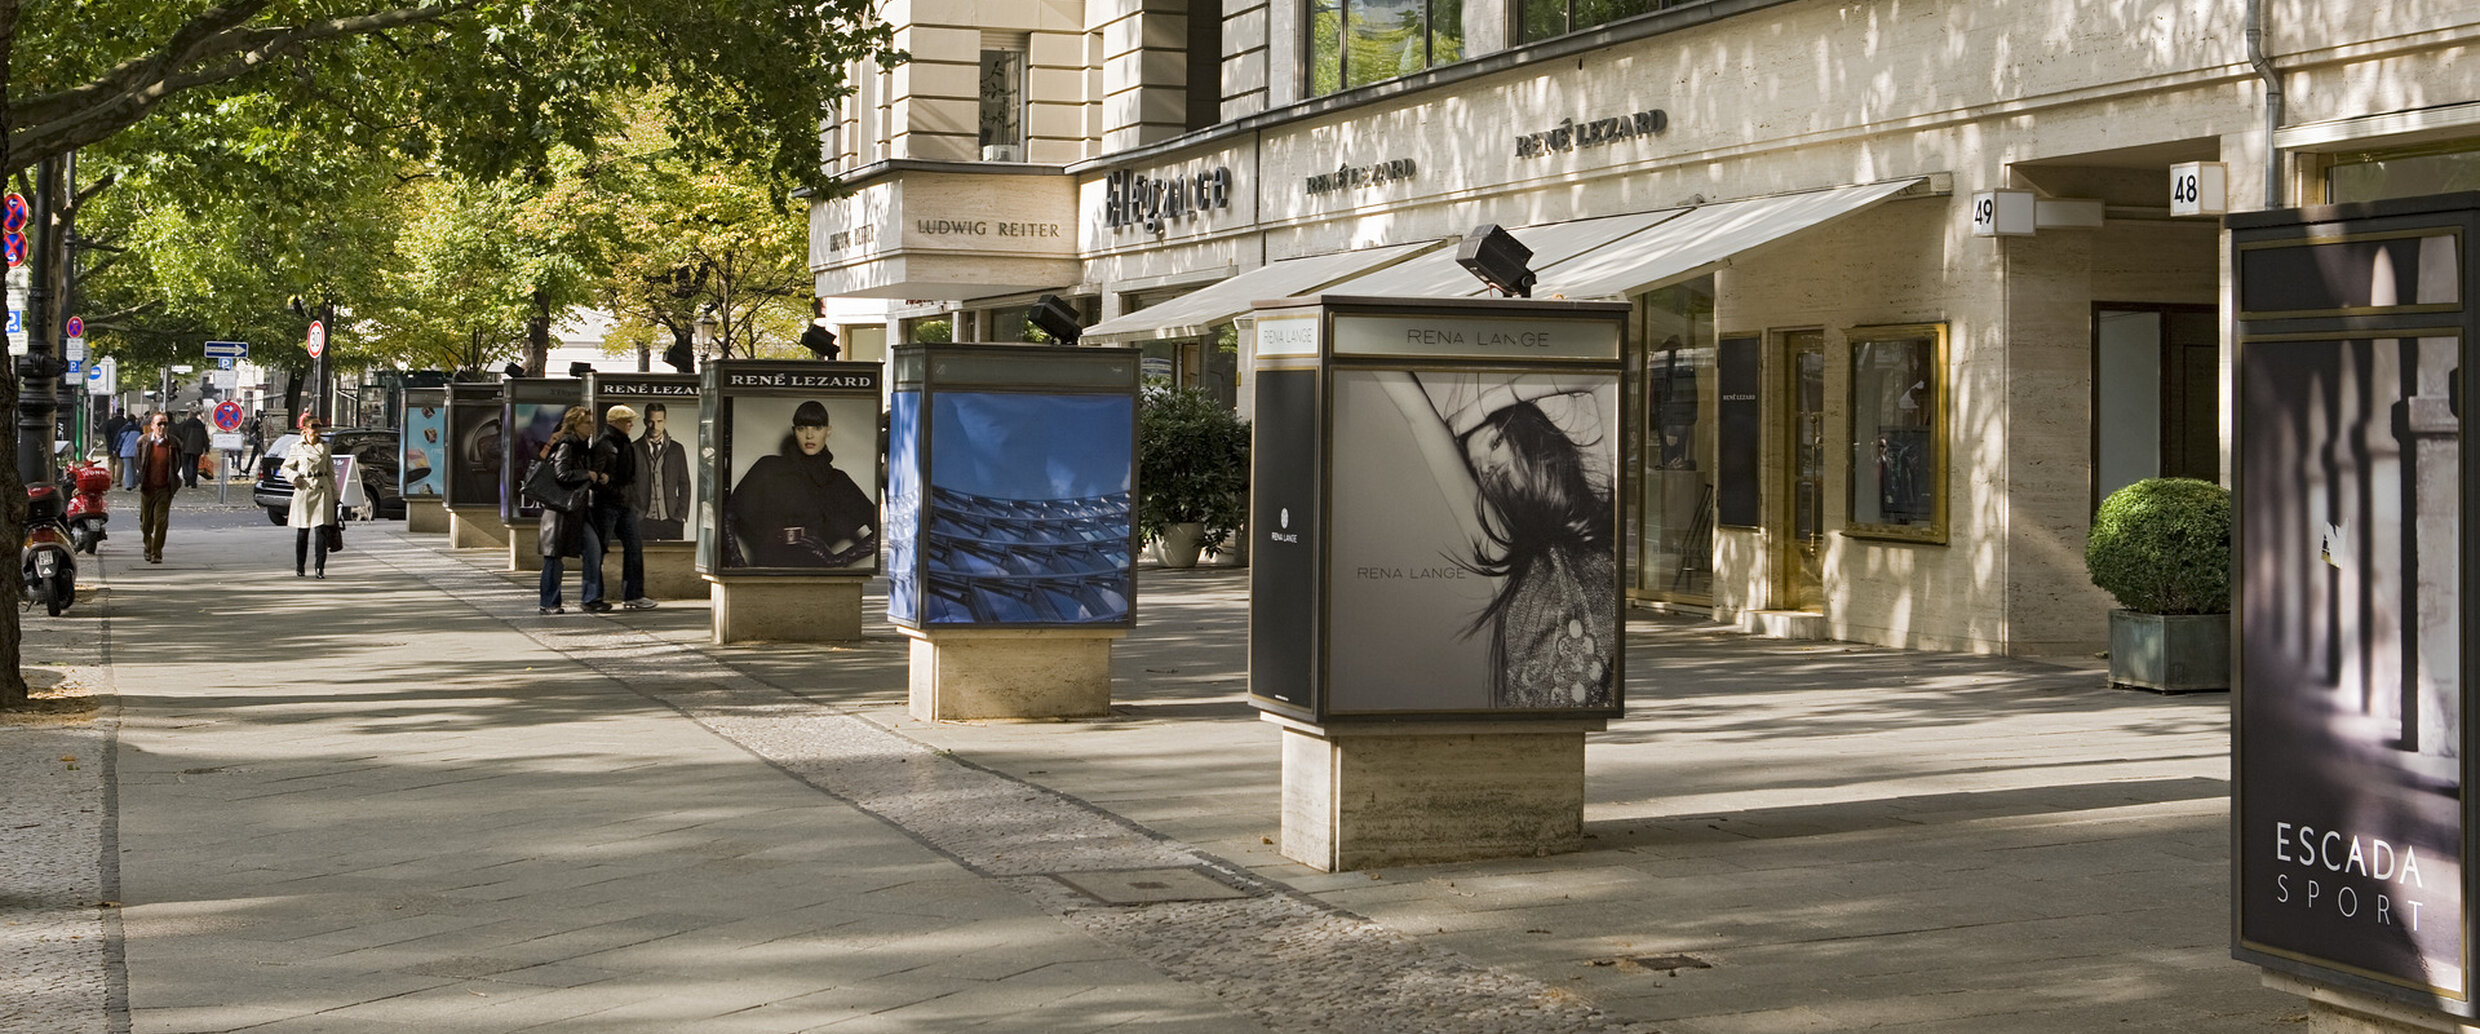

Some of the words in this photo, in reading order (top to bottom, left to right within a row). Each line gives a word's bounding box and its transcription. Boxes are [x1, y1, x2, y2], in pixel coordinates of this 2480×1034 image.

[1514, 118, 1573, 158] RENÉ
[1575, 109, 1668, 148] LEZARD
[2174, 175, 2197, 204] 48
[1104, 167, 1232, 236] Elegance
[1974, 198, 1993, 226] 49
[917, 219, 987, 236] LUDWIG
[998, 222, 1060, 238] REITER
[311, 331, 320, 347] 30
[1263, 329, 1285, 344] RENA
[1286, 327, 1312, 343] LANGE
[1407, 329, 1465, 345] RENA
[1477, 331, 1550, 347] LANGE
[730, 373, 786, 387] RENÉ
[791, 376, 871, 388] LEZARD
[603, 384, 648, 395] RENÉ
[652, 386, 700, 396] LEZA
[1271, 531, 1283, 541] RENA
[1283, 533, 1298, 544] LANGE
[1357, 567, 1403, 580] RENA
[1410, 567, 1467, 580] LANGE
[2276, 821, 2423, 889] ESCADA
[2276, 873, 2424, 932] SPORT
